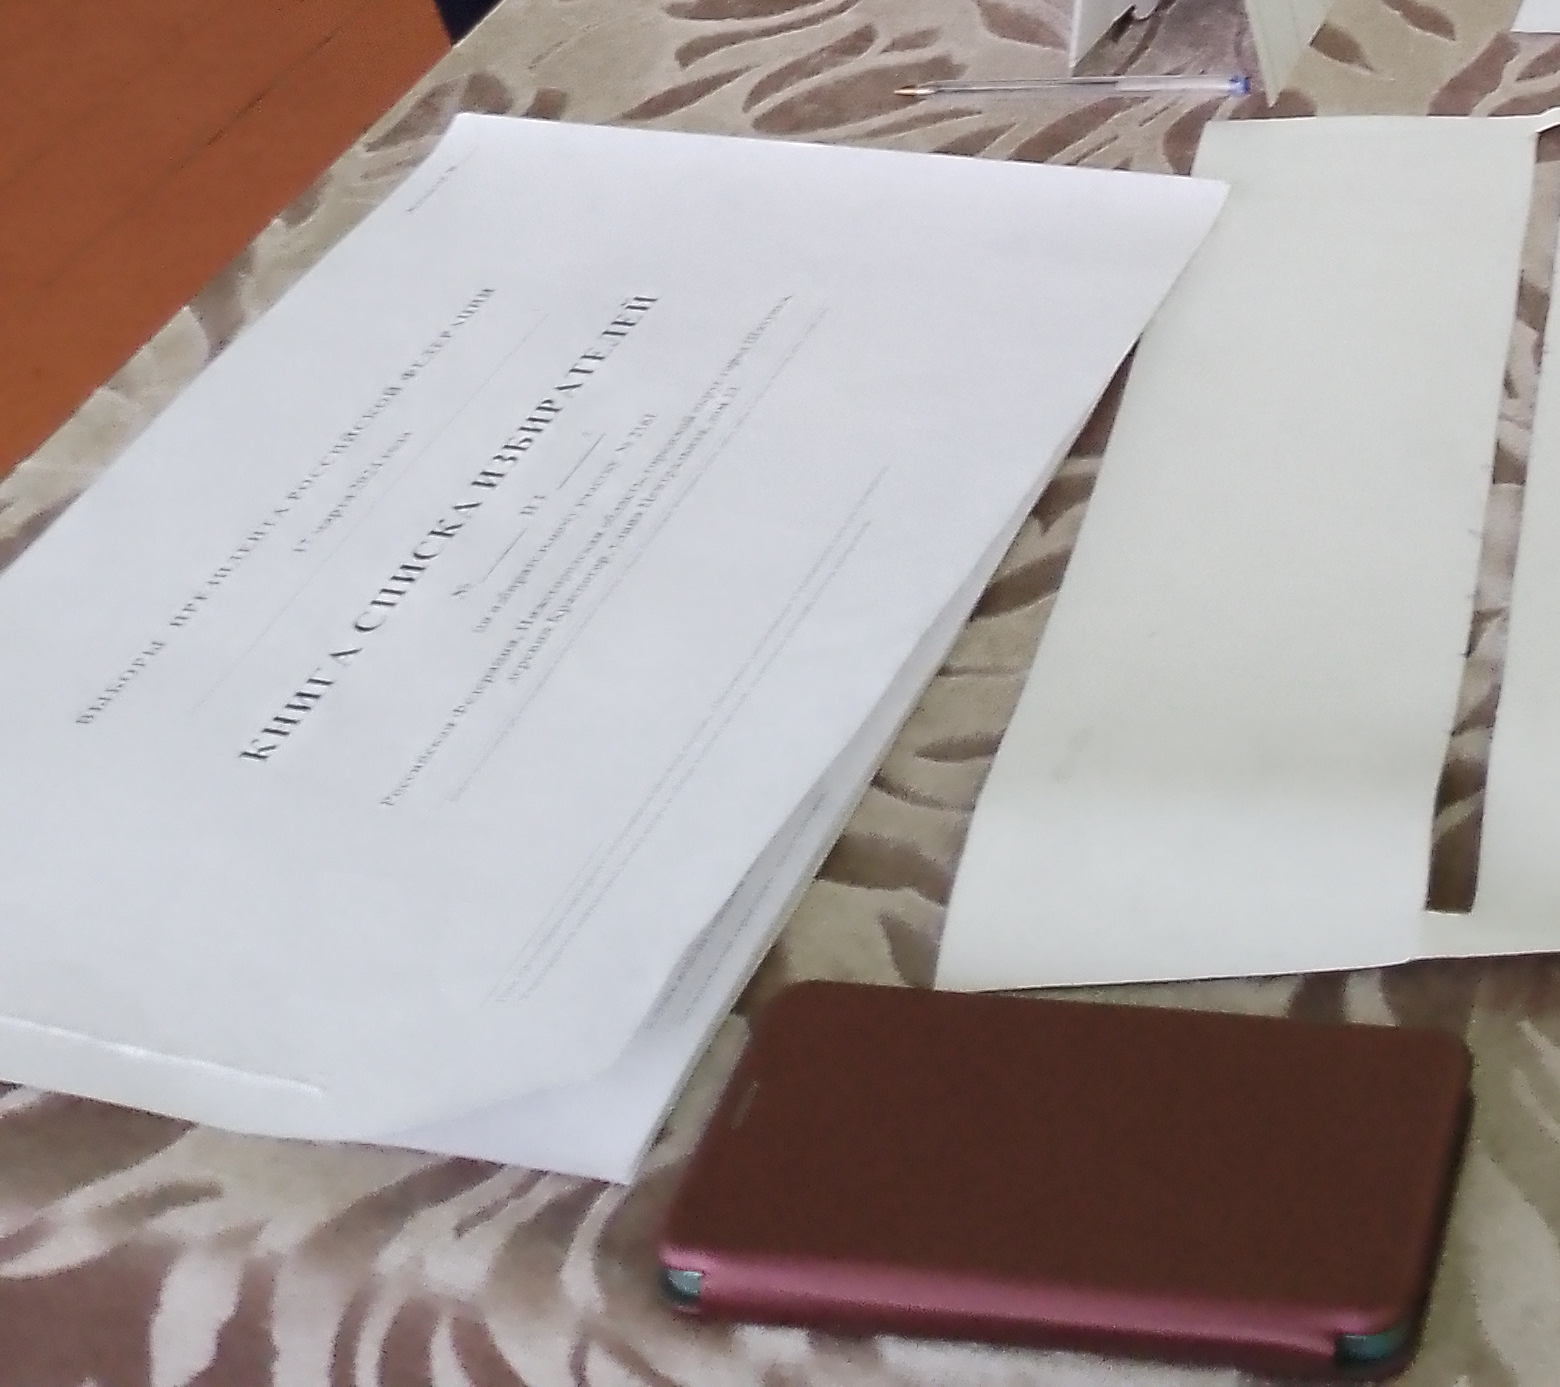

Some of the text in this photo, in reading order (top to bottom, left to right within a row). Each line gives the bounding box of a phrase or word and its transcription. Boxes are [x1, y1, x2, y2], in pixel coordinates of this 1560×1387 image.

[73, 636, 167, 730] ВЫБОРЫ
[165, 504, 292, 630] ПРЕЗИДЕНТА
[284, 385, 405, 502] РОССИЙСКОЙ
[395, 287, 498, 381] ФЕДЕРАЦИИ
[239, 294, 660, 770] КНИГА СПИСКА ИЗБИРАТЕЛЕЙ
